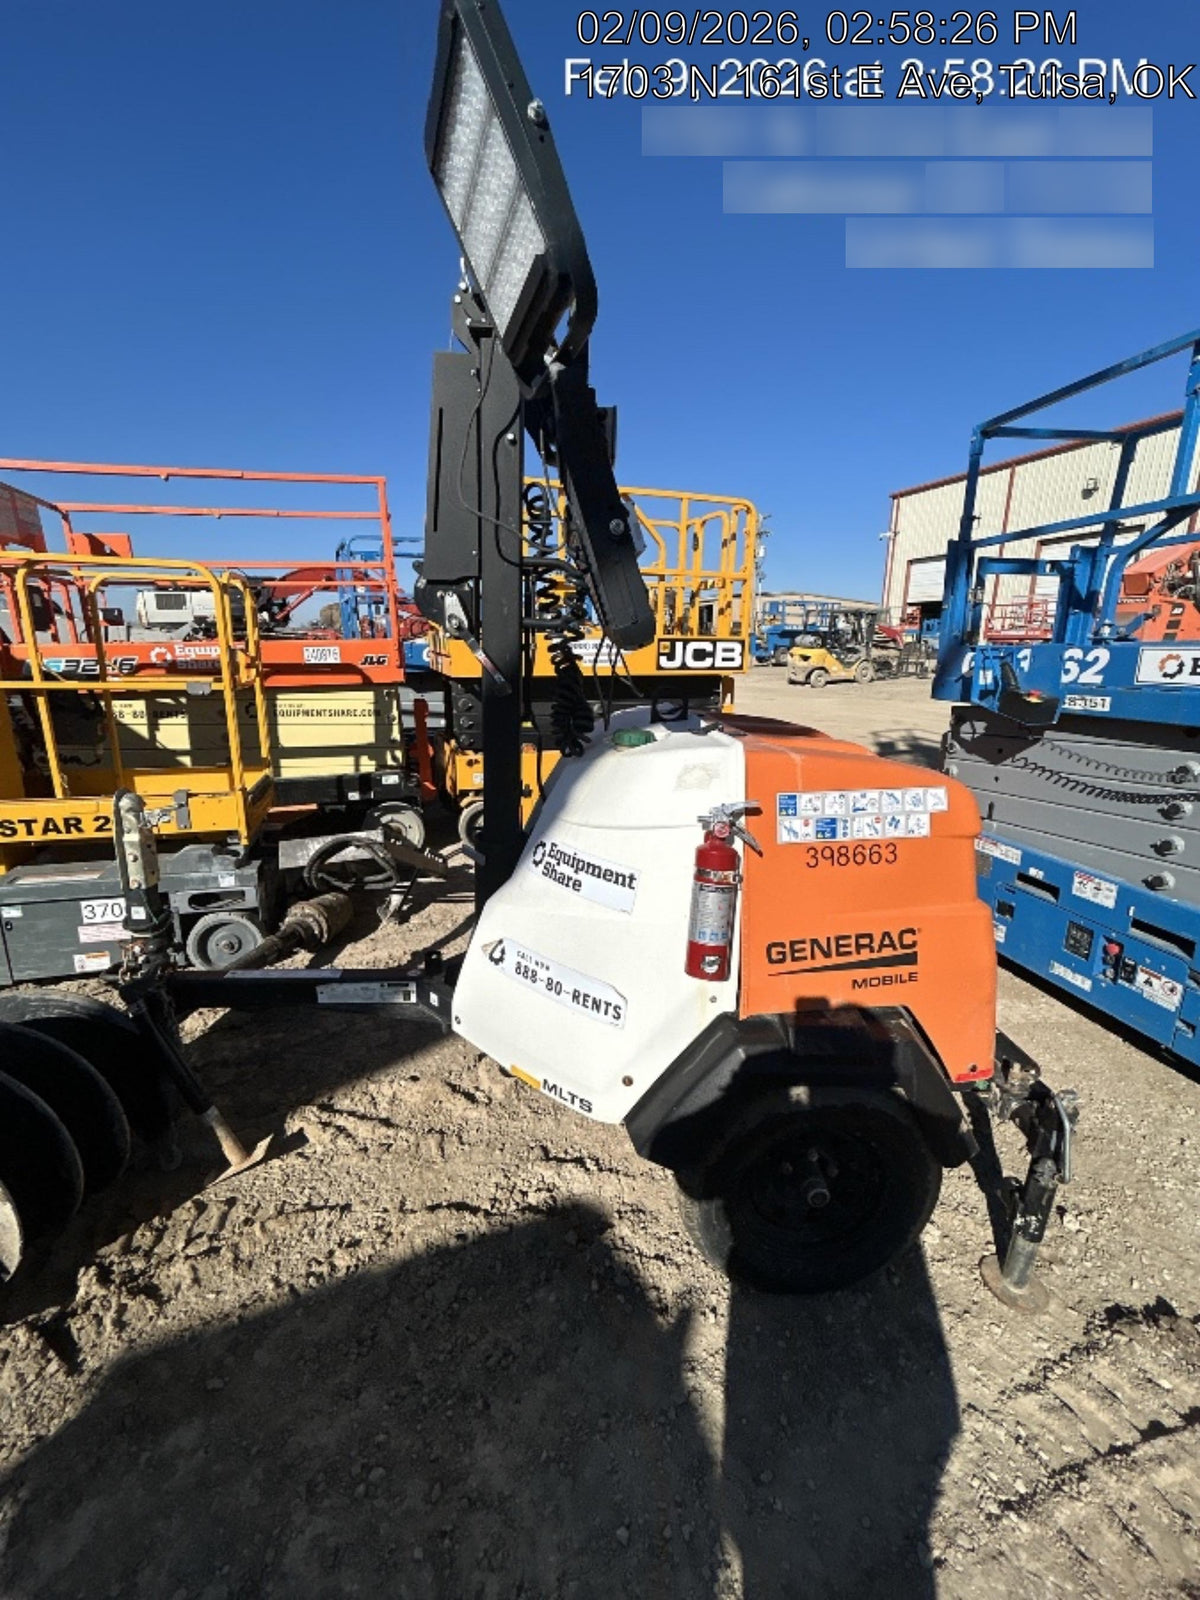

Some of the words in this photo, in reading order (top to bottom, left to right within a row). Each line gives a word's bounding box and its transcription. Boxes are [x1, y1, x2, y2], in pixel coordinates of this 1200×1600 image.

[360, 655, 388, 666] JLG
[659, 641, 742, 669] JCB
[0, 816, 86, 838] STAR
[92, 815, 113, 833] 2
[547, 841, 637, 890] Equipment
[805, 842, 898, 869] 398663
[541, 861, 583, 892] Share
[83, 901, 123, 920] 370
[766, 927, 918, 965] GENERAC
[514, 961, 622, 1021] 888-80-RENTS
[852, 971, 918, 990] MOBILE
[542, 1078, 593, 1113] MLTS
